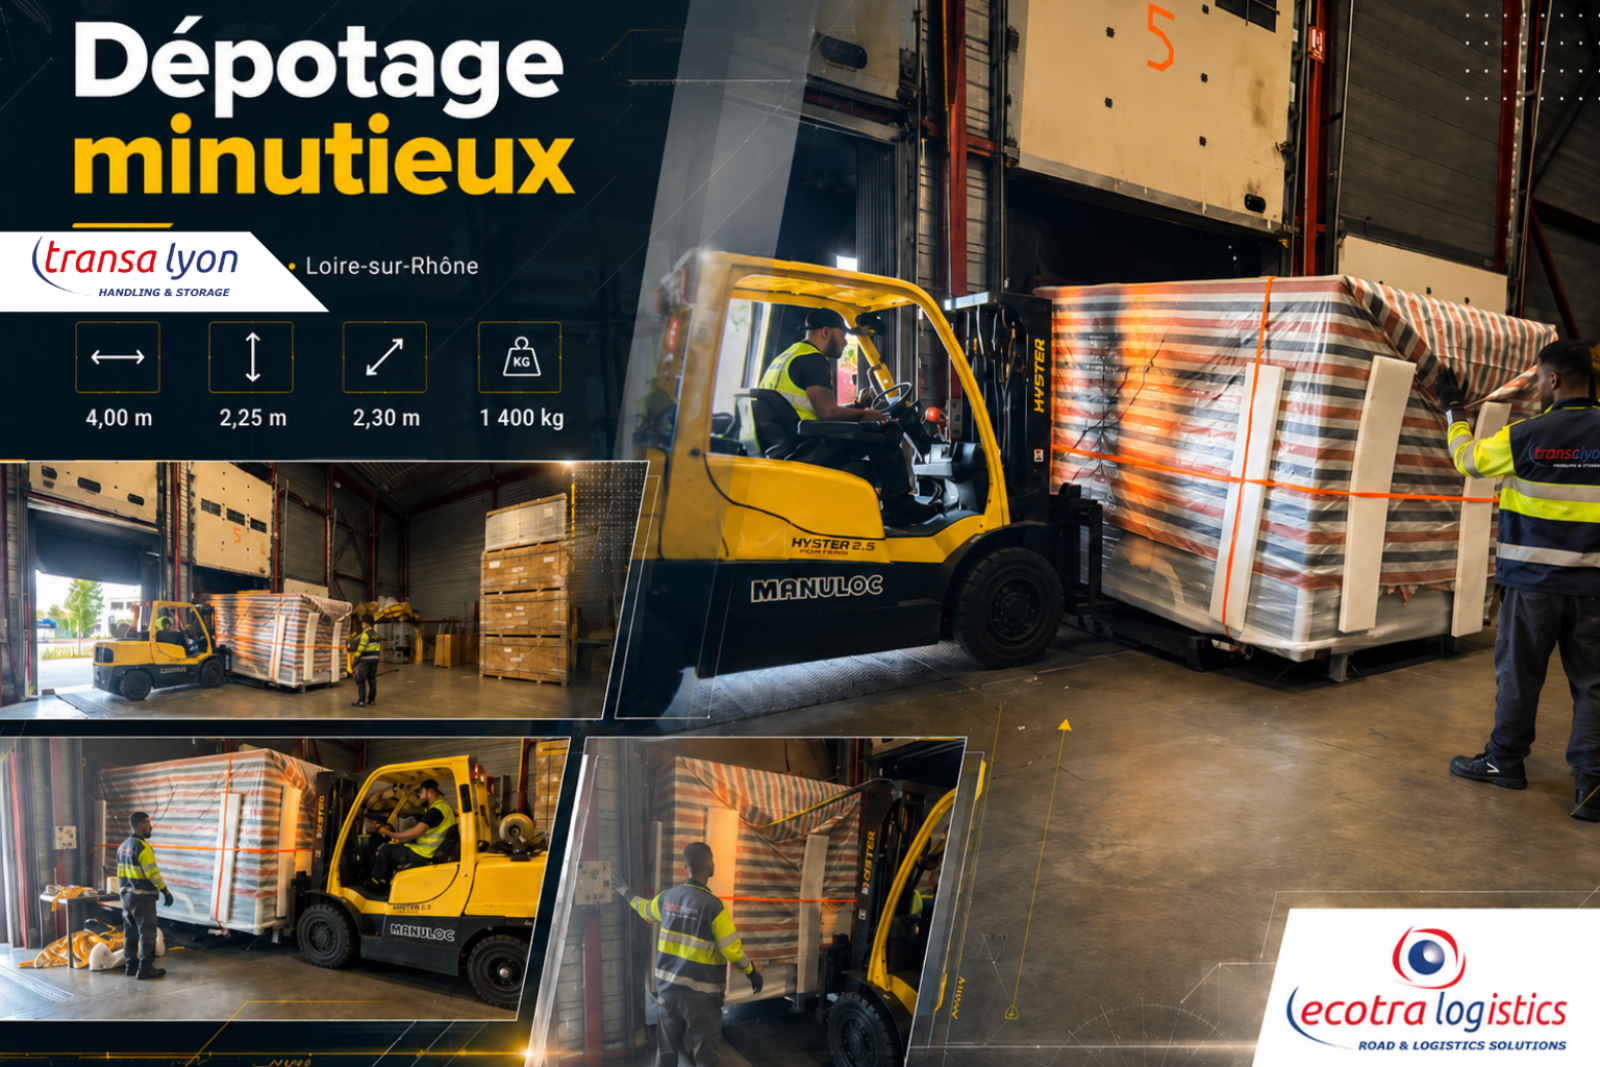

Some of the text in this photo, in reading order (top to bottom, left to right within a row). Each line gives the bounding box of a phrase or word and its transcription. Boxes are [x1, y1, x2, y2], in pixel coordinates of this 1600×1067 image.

[1147, 3, 1174, 72] 5
[1033, 338, 1046, 413] HYSTER
[791, 537, 876, 551] HYSTER 2.5
[750, 574, 884, 603] MANULOC
[390, 922, 456, 943] MANULOC
